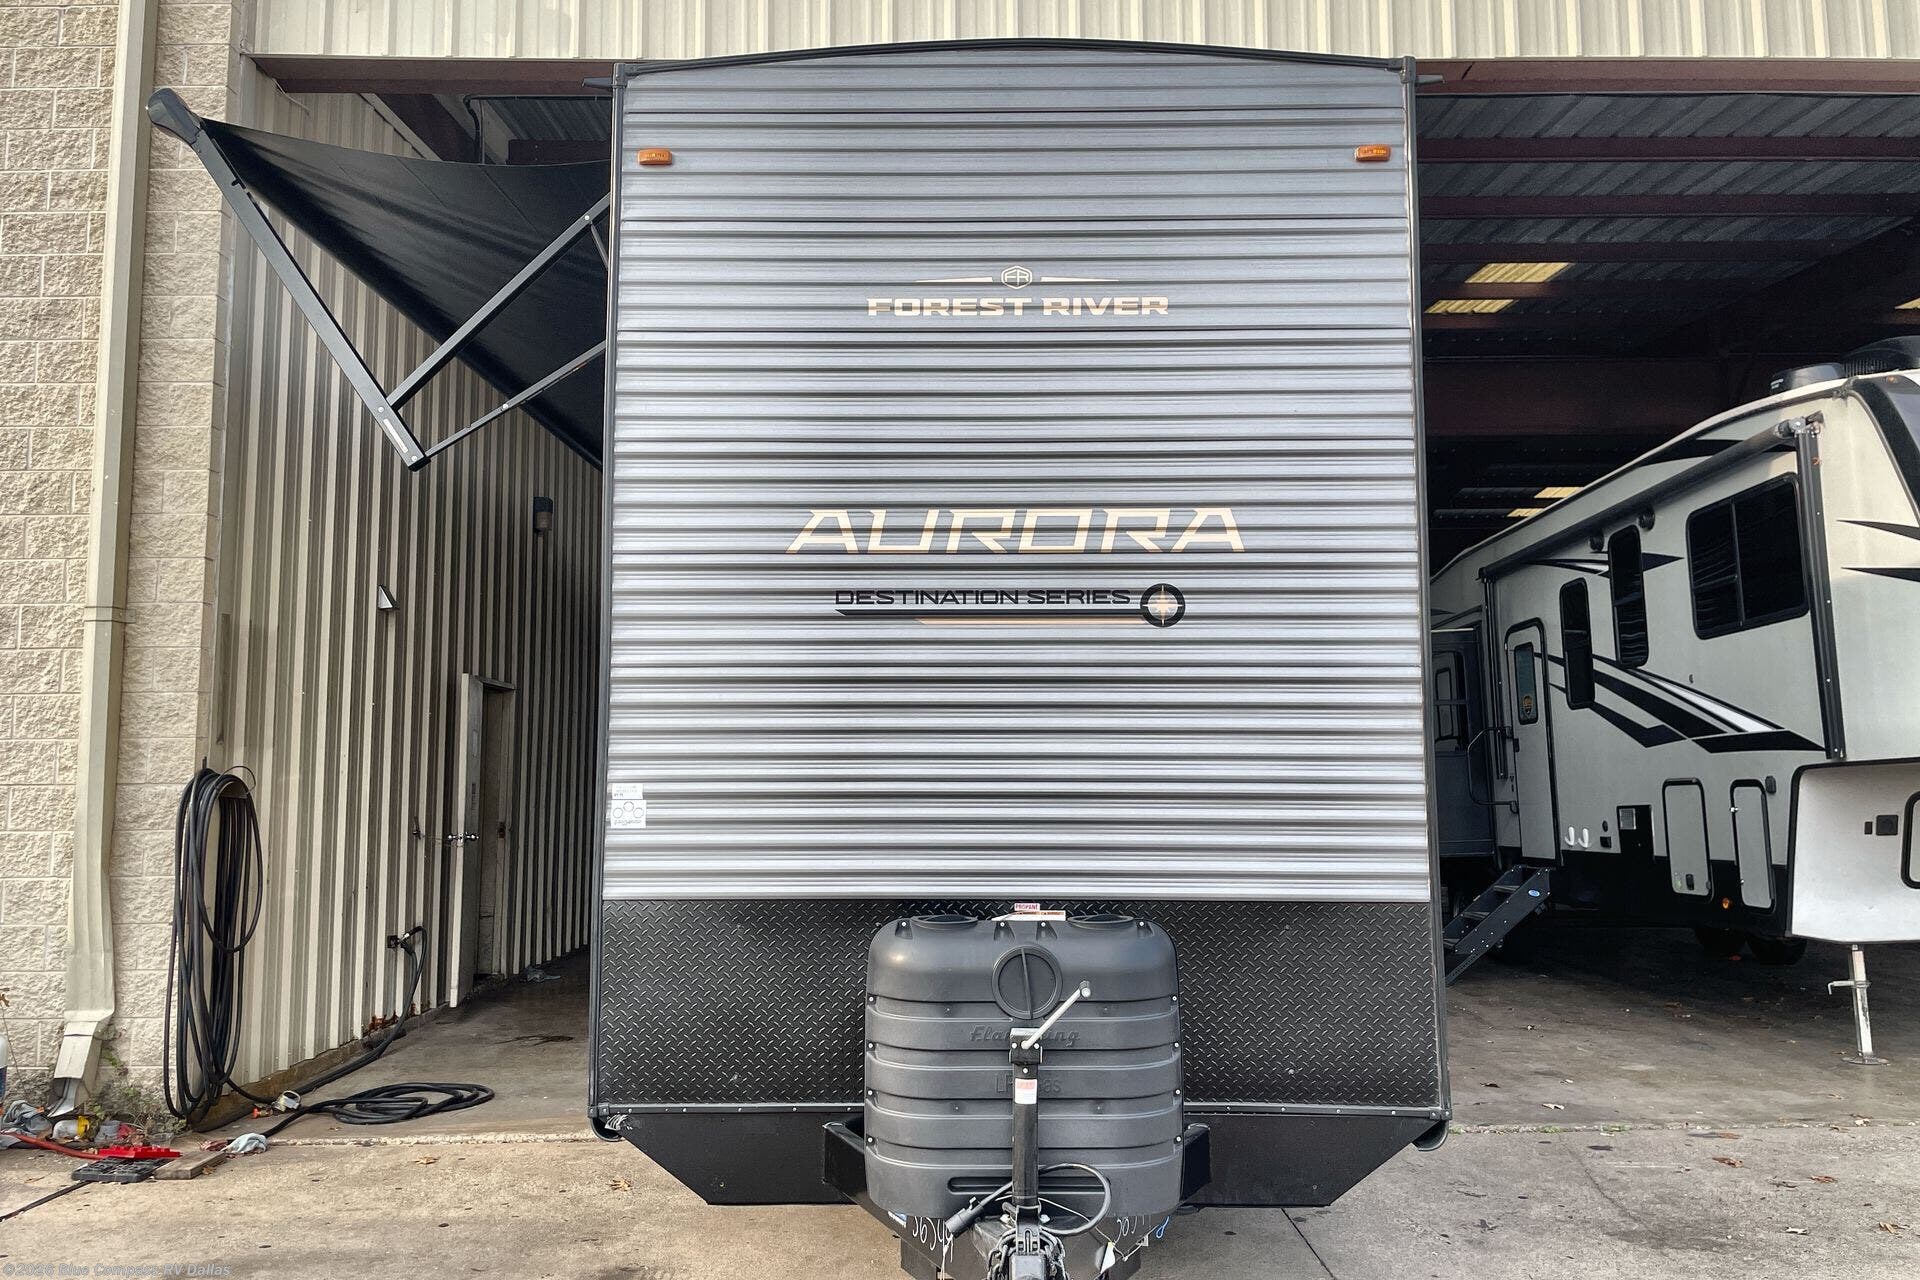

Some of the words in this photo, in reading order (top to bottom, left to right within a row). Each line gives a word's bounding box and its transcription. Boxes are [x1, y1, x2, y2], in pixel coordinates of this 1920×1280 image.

[866, 297, 1032, 316] FOREST
[1041, 296, 1169, 315] RIVER
[785, 507, 1246, 554] AURORA
[835, 590, 1021, 605] DESTINATION
[1027, 589, 1131, 605] SERIES
